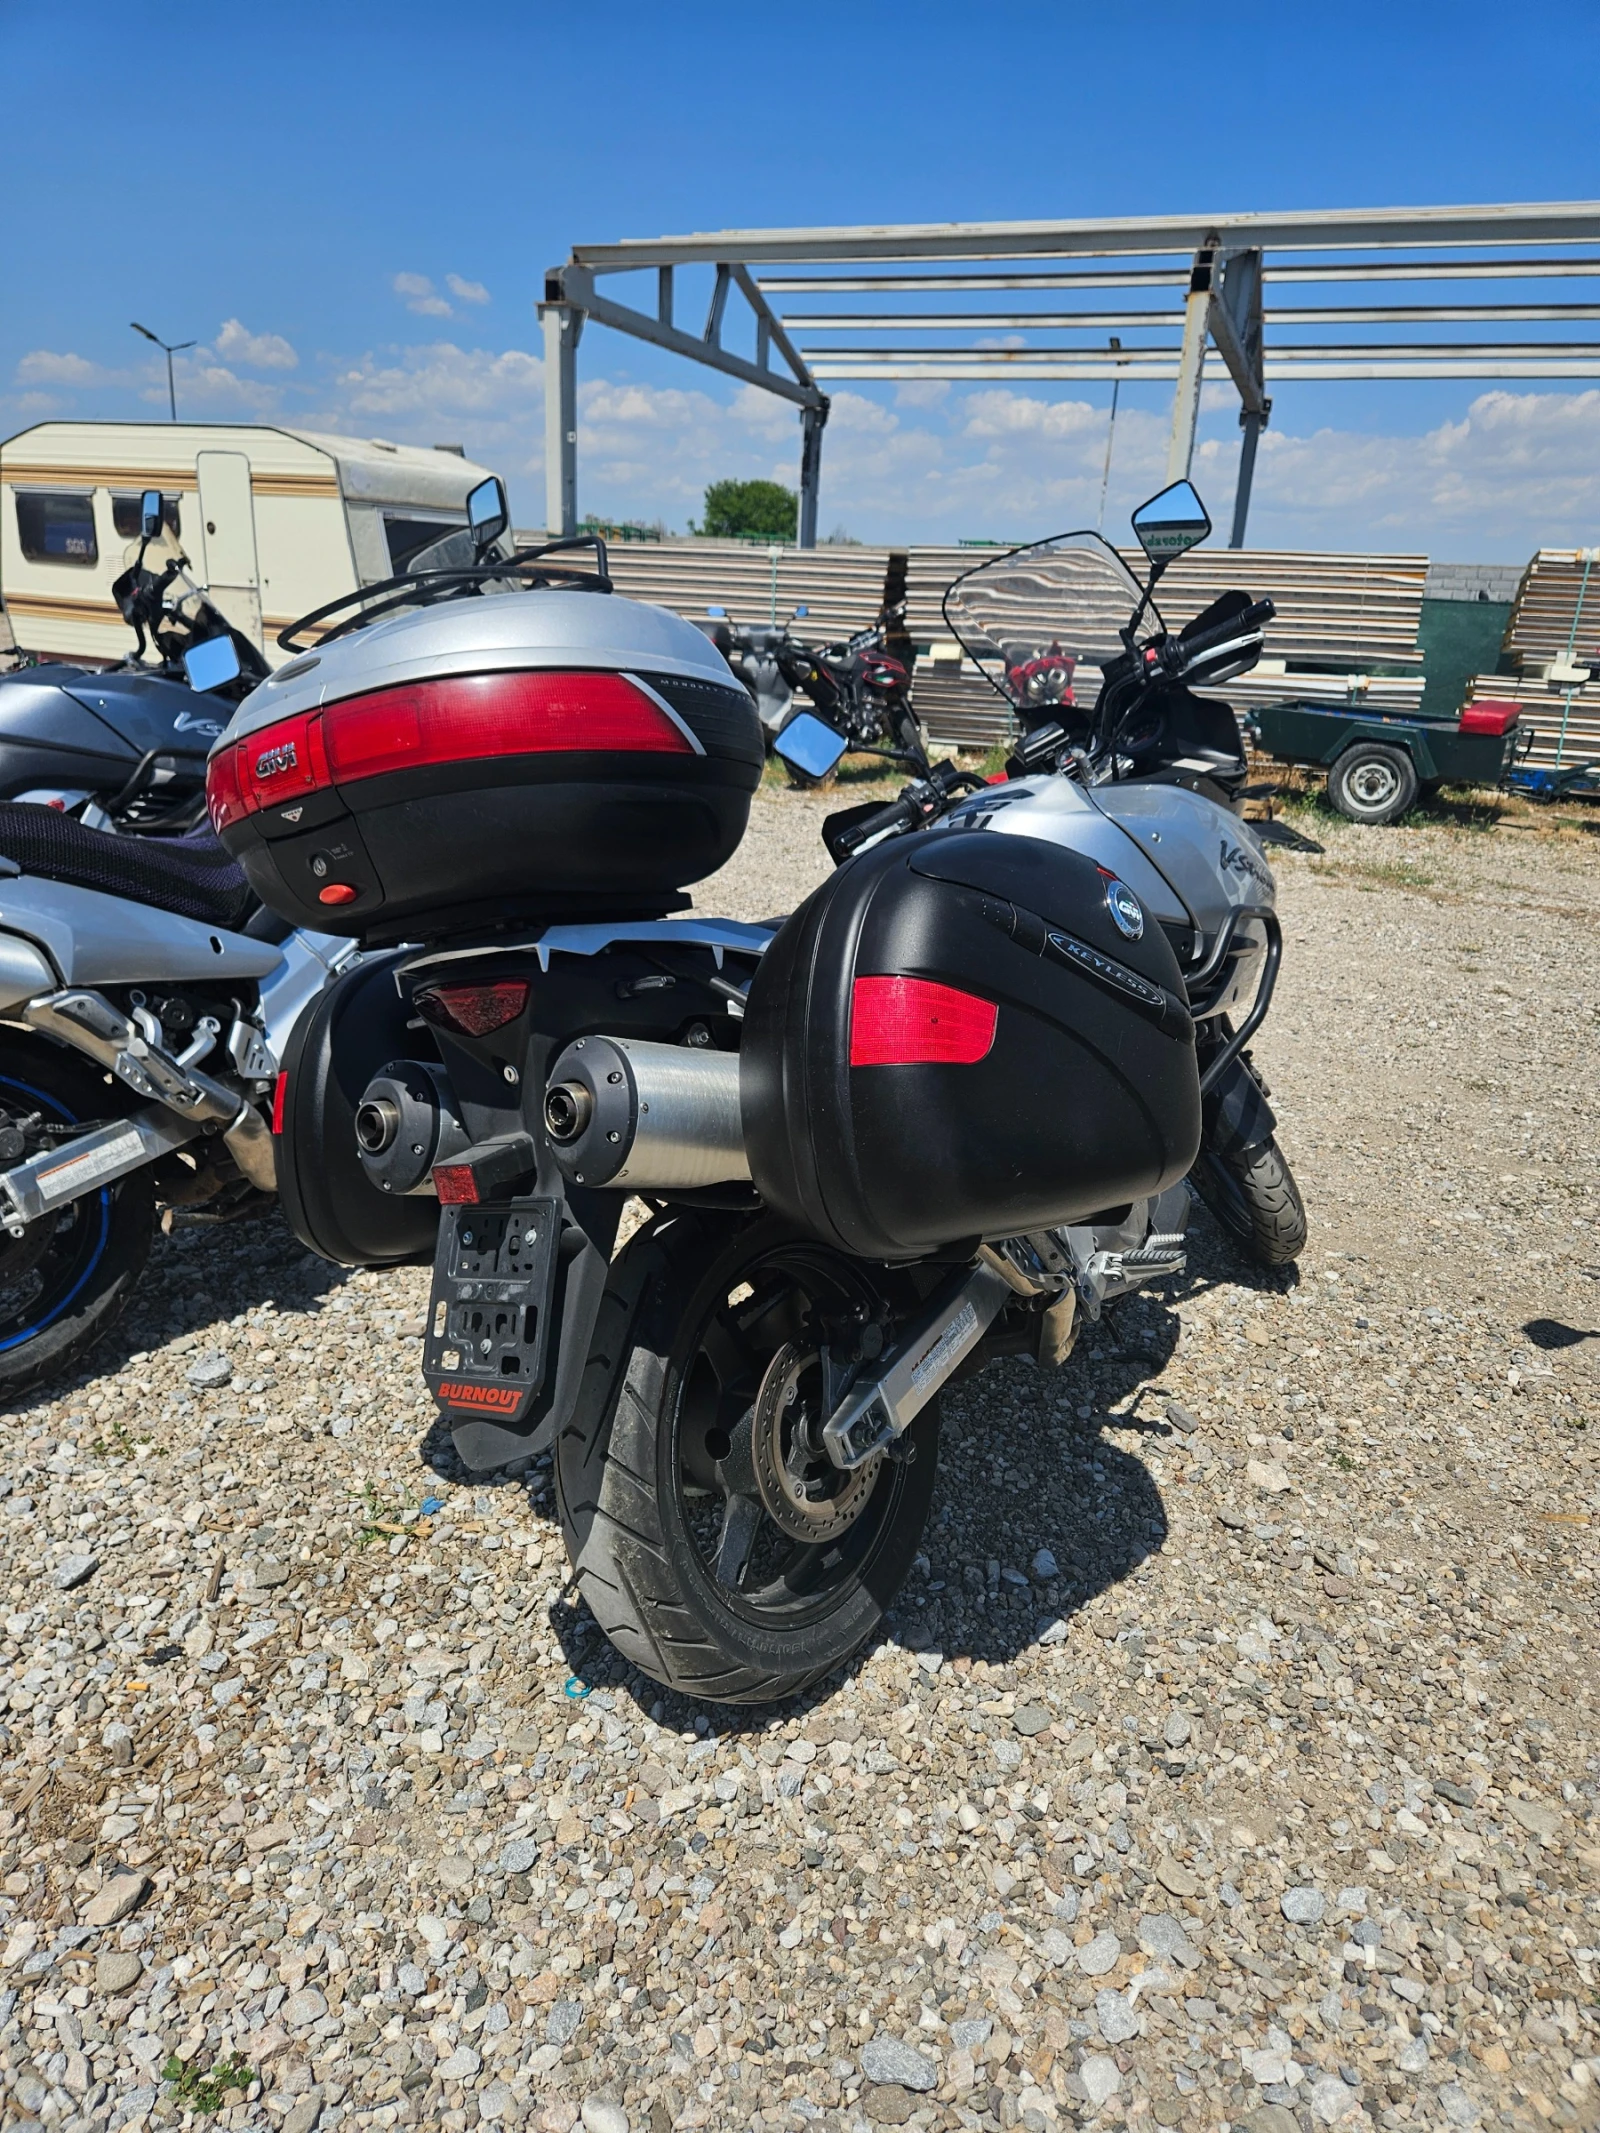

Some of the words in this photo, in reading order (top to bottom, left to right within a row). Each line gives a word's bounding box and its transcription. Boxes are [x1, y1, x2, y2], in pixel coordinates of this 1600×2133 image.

[256, 741, 297, 778] GIVI
[1067, 943, 1148, 995] KEYLESS
[437, 1382, 524, 1413] BURNOUT
